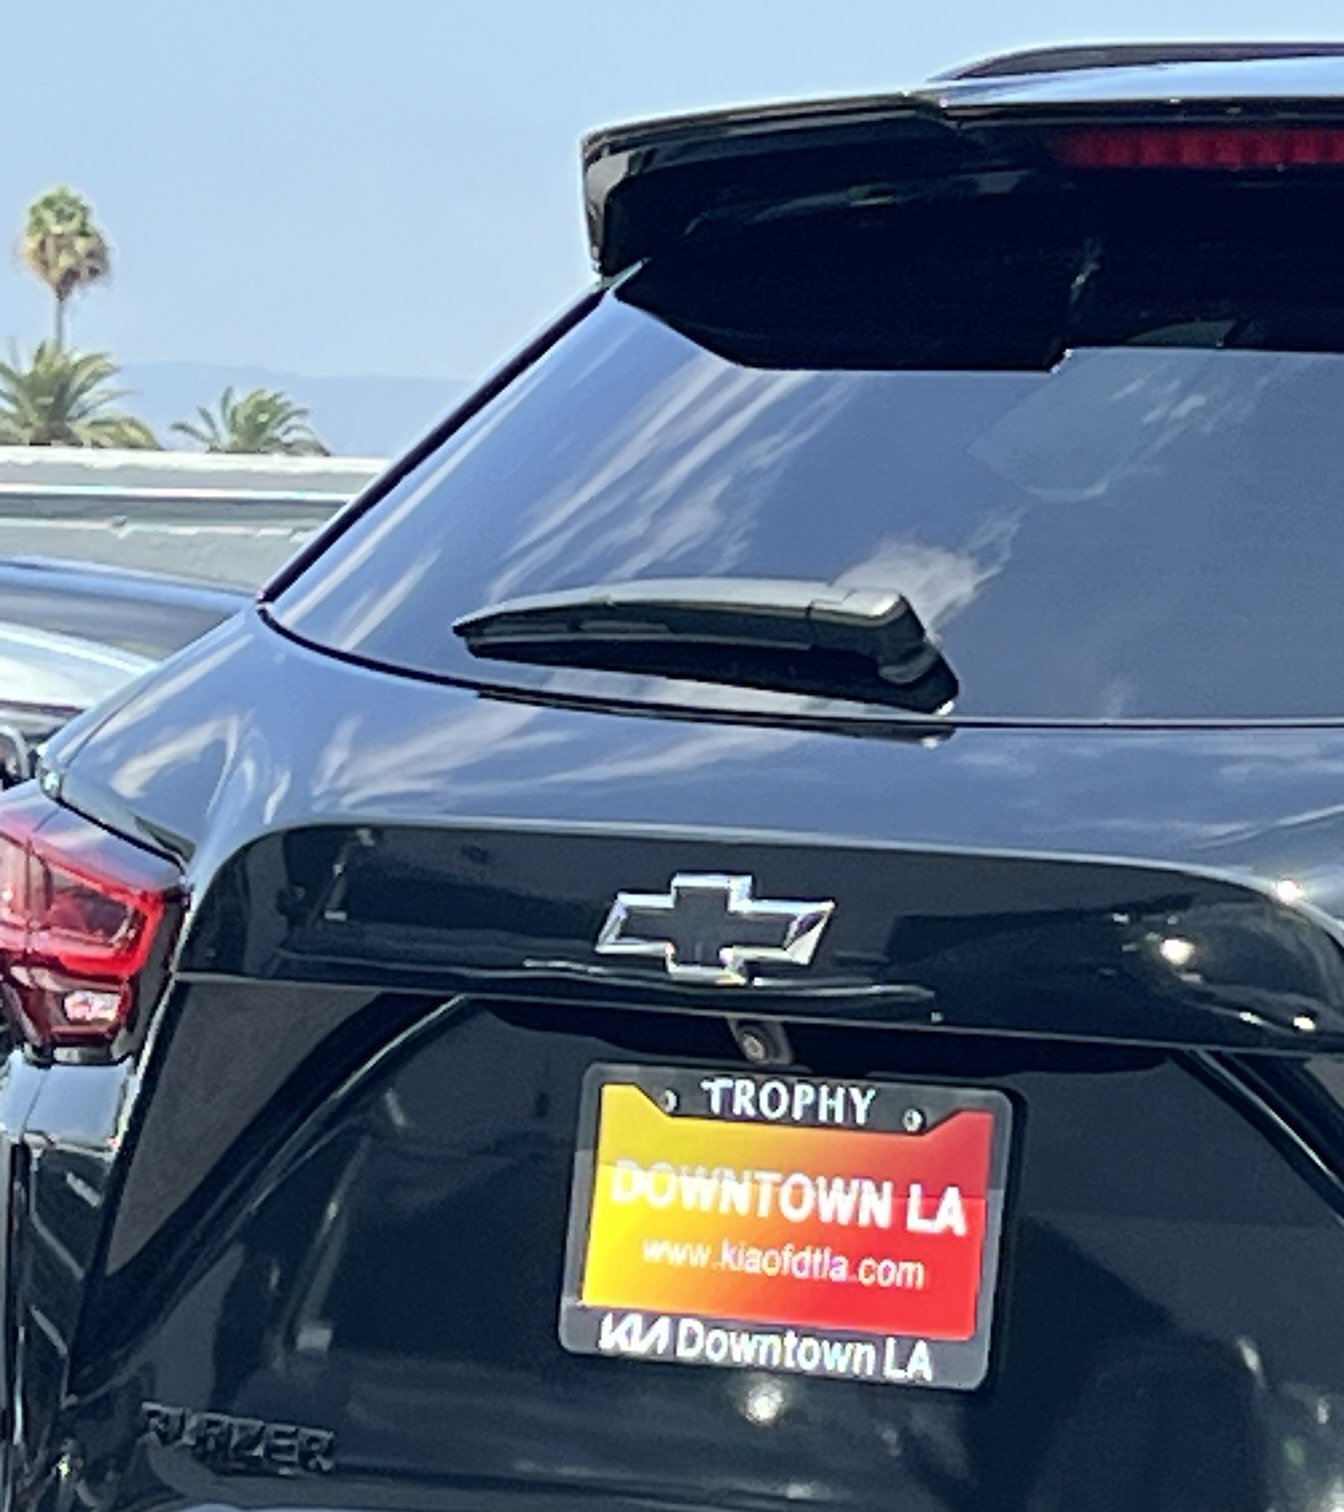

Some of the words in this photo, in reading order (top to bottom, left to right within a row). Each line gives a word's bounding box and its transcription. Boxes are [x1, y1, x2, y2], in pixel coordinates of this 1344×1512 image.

[701, 1077, 877, 1125] TROPHY
[611, 1159, 892, 1230] DOWNTOWN
[905, 1183, 968, 1236] LA
[641, 1237, 926, 1290] www.kiaofdtla.com
[675, 1322, 877, 1378] Downtown
[882, 1340, 933, 1382] LA
